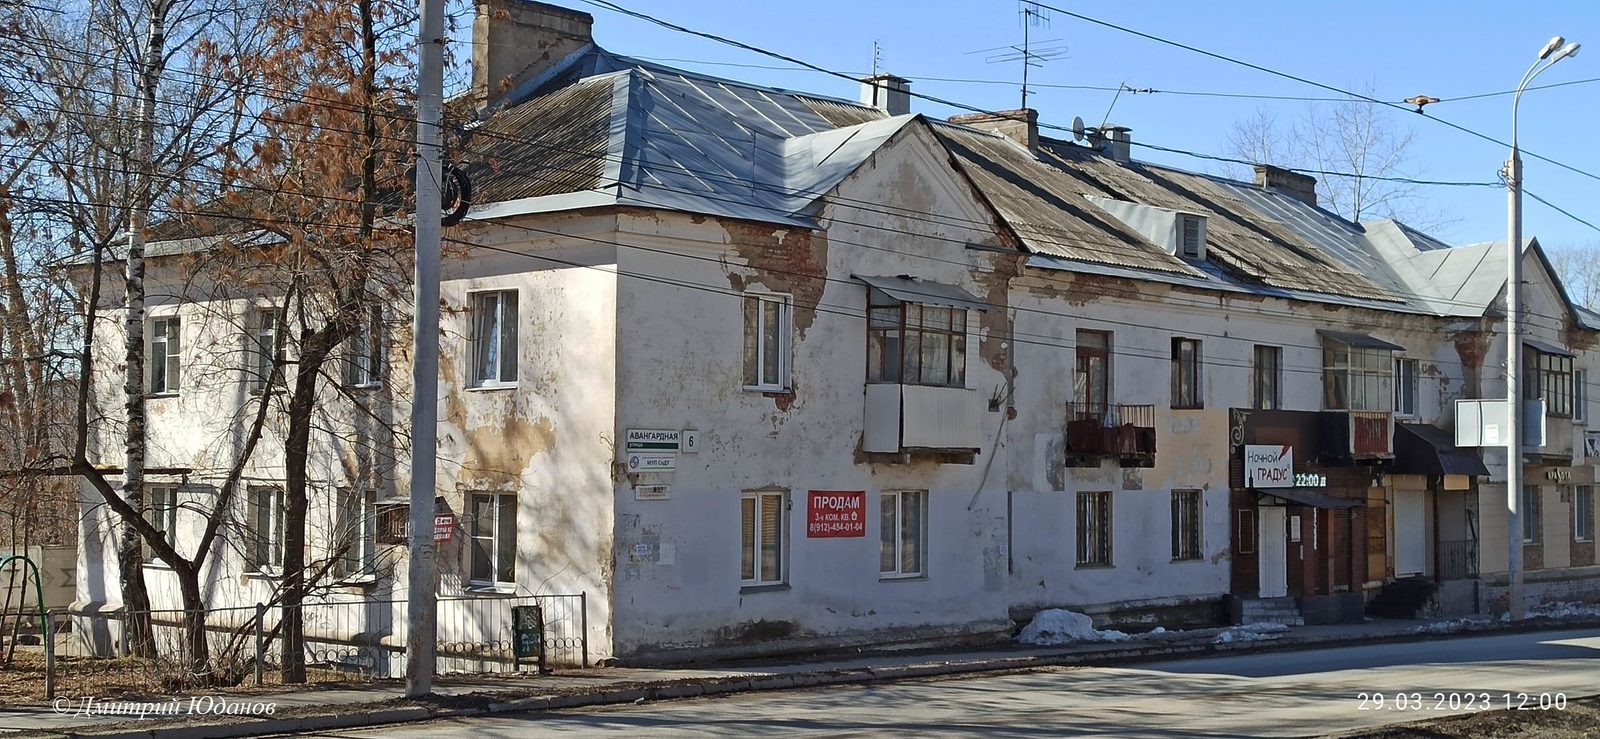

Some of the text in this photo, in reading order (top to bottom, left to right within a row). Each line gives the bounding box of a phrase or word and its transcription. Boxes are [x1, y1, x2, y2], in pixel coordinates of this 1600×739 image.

[629, 432, 678, 441] АВАНГАРДНАЯ
[688, 435, 694, 447] 6
[1247, 450, 1278, 463] Ночной
[1257, 468, 1288, 482] ГРАДУС
[1295, 474, 1319, 487] 22:00
[813, 496, 860, 511] ПРОДАМ
[841, 513, 851, 521] КВ.
[809, 522, 863, 533] 8(912)-454-01-04
